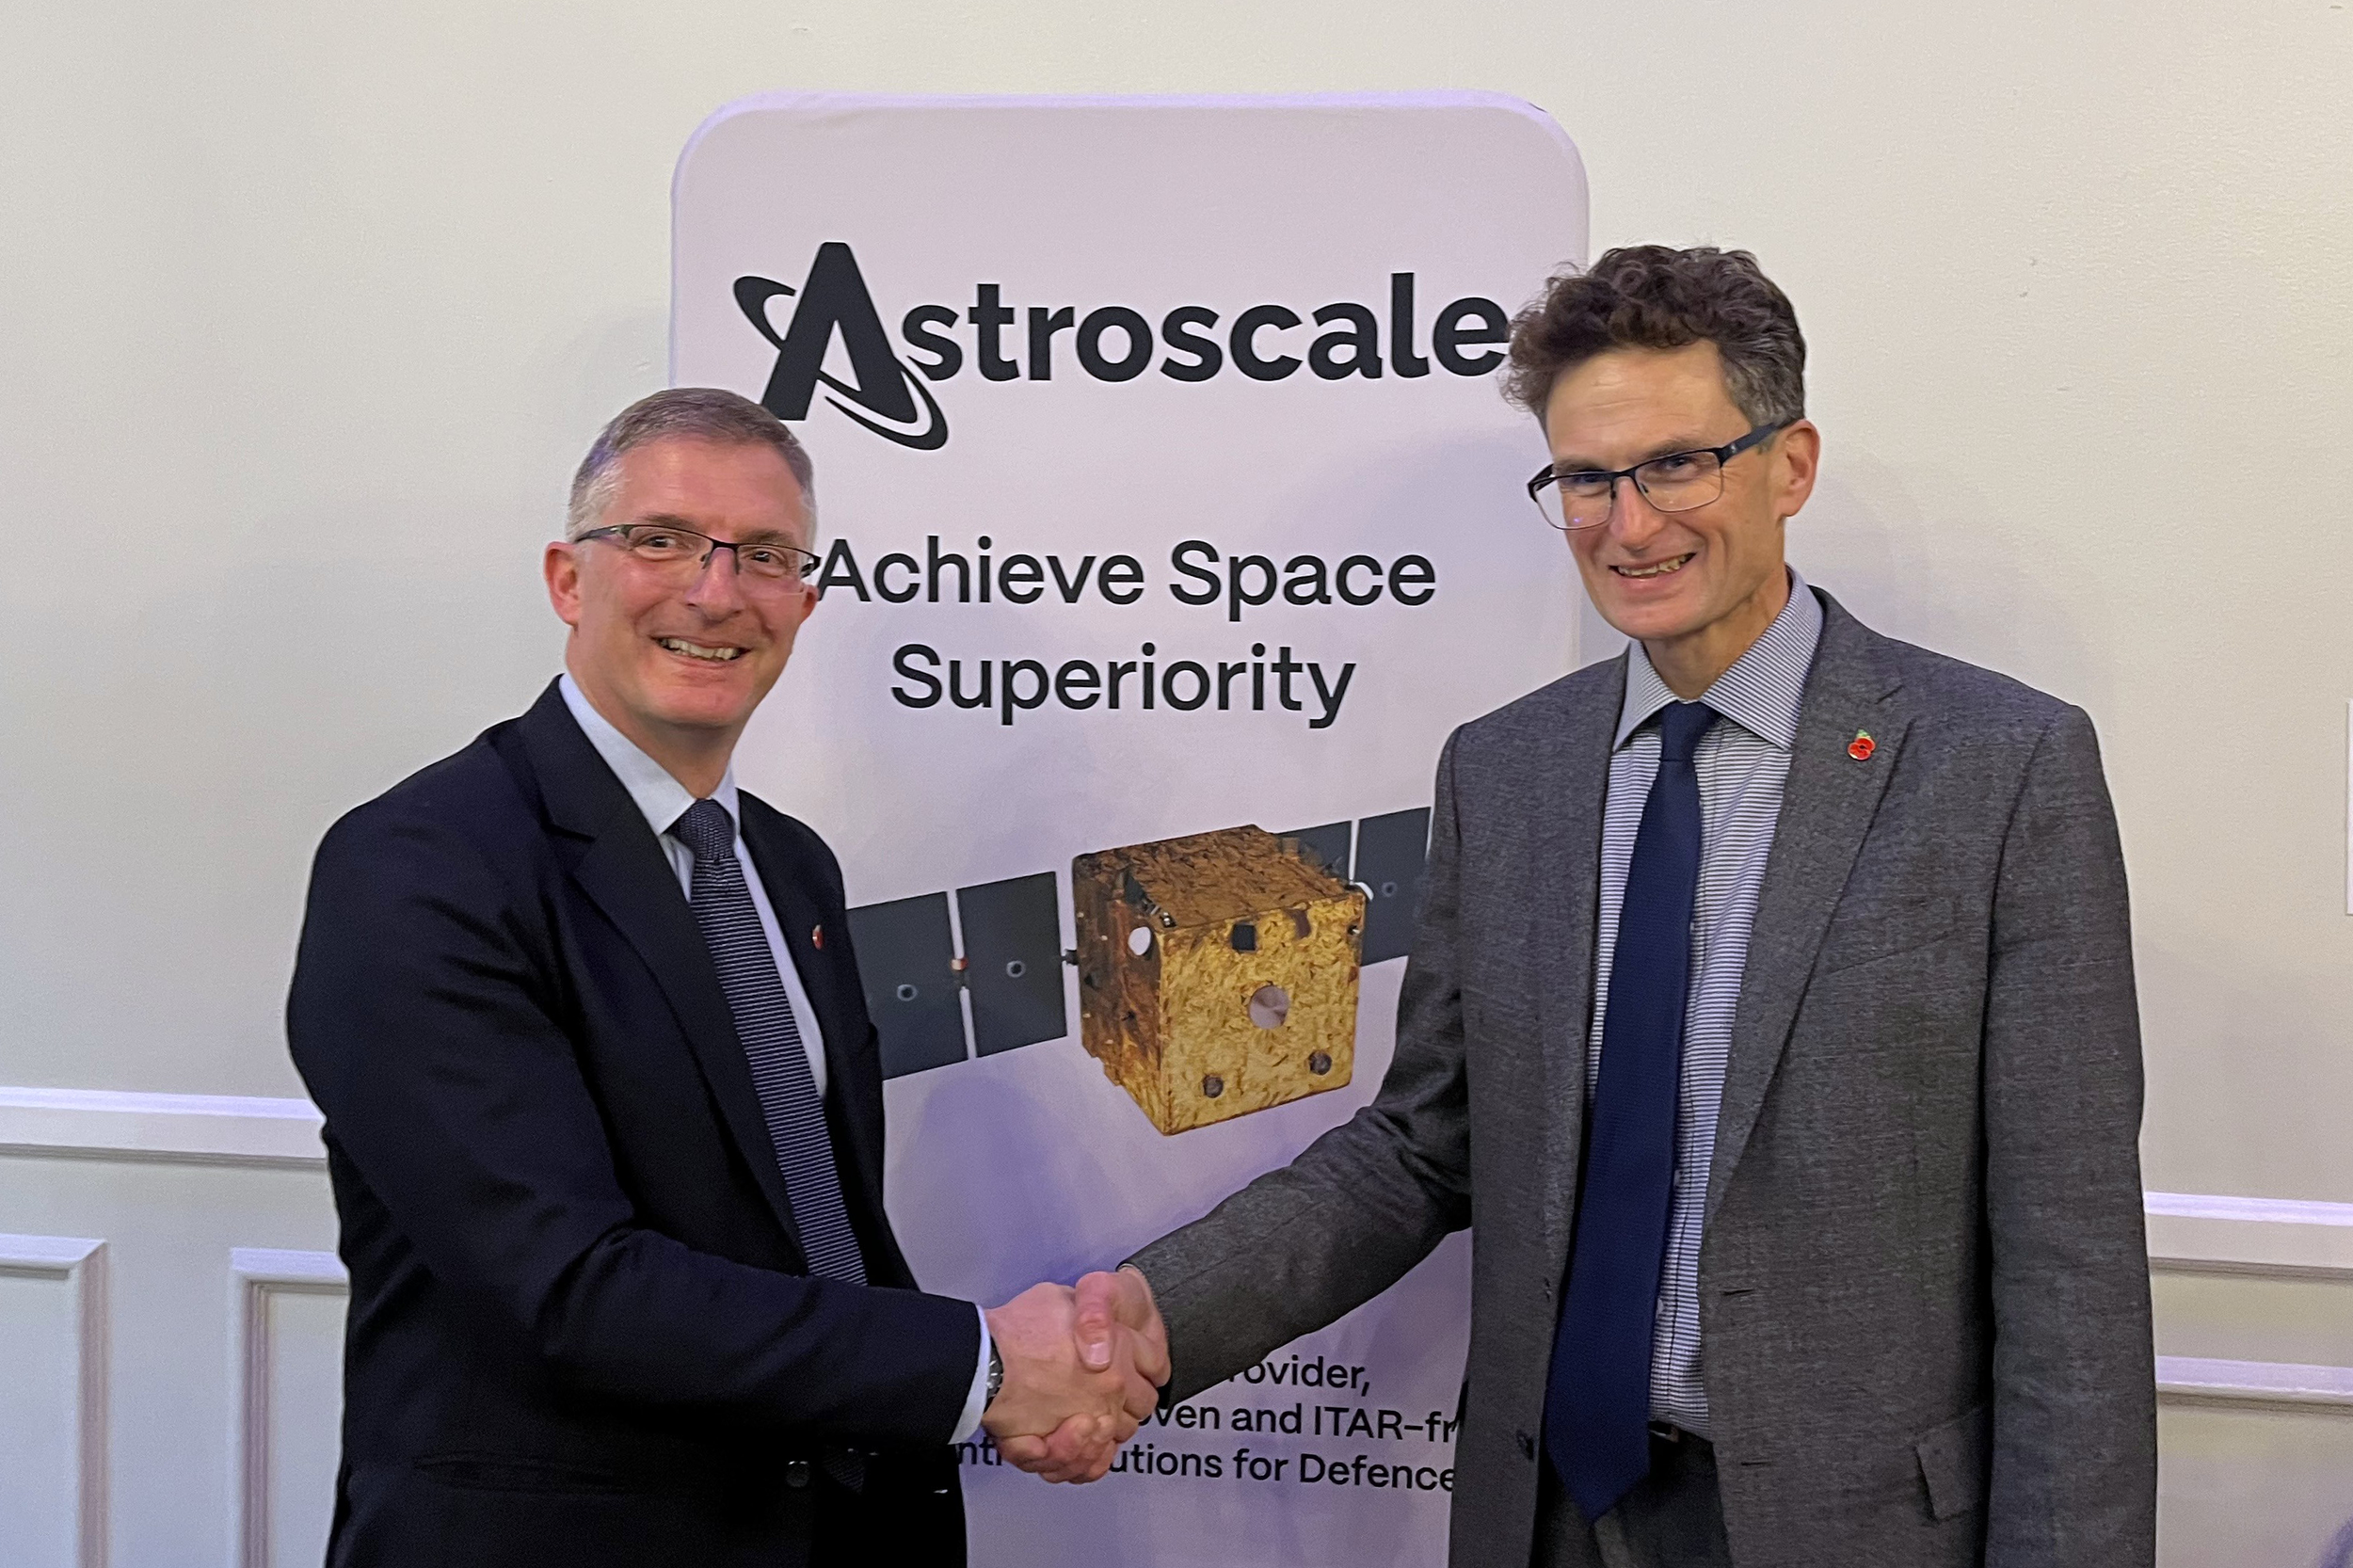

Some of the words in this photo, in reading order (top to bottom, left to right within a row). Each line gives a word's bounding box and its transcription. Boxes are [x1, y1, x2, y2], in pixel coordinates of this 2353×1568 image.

[732, 241, 1511, 451] Astroscale
[817, 535, 1145, 608] Achieve
[1169, 539, 1436, 622] Space
[890, 642, 1357, 729] Superiority
[1229, 1353, 1370, 1398] ovider,
[1230, 1402, 1303, 1434] and
[1314, 1405, 1454, 1444] ITAR-fr
[1110, 1443, 1223, 1479] utions
[1232, 1448, 1289, 1481] for
[1299, 1452, 1454, 1493] Defence
